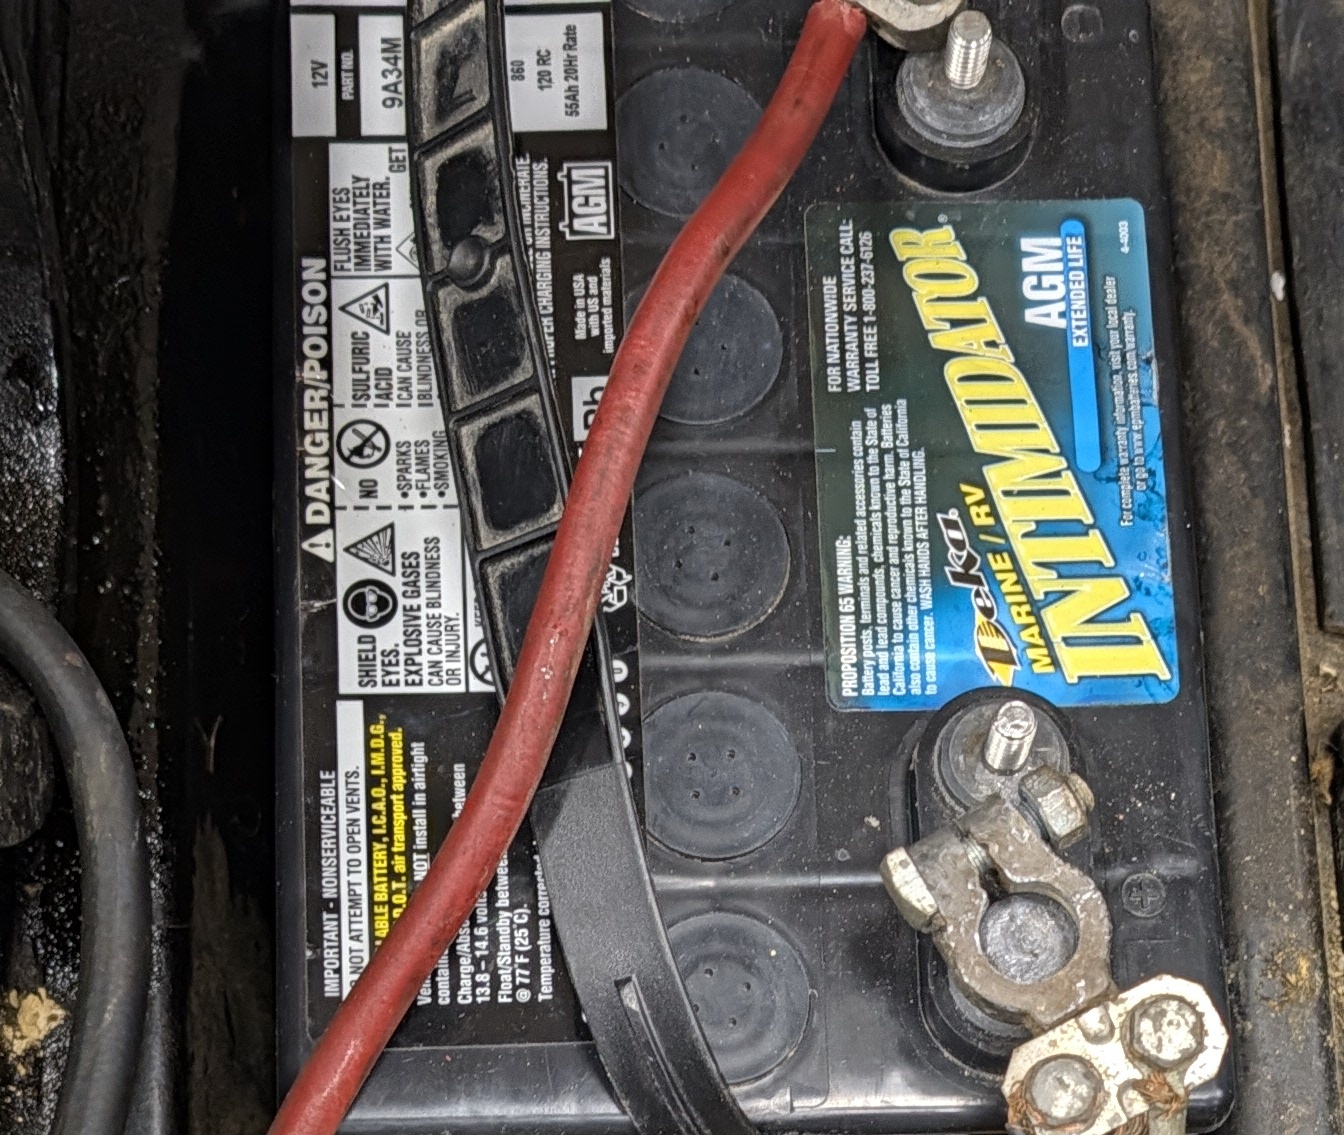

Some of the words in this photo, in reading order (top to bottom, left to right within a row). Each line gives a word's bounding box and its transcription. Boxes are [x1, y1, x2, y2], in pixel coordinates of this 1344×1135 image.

[564, 24, 578, 52] Rate
[311, 60, 328, 88] 12V
[341, 48, 354, 70] NO.
[381, 37, 404, 109] 9A34M
[510, 60, 525, 81] 860
[537, 48, 552, 67] RC
[564, 54, 579, 82] 20Hr
[342, 72, 354, 100] PART
[537, 70, 553, 91] 120
[564, 84, 580, 117] 55Ah
[389, 147, 406, 173] GET
[332, 188, 350, 224] EYES
[374, 176, 391, 230] WATER.
[532, 157, 551, 248] INSTRUCTIONS.
[572, 168, 608, 234] AGM
[352, 175, 372, 271] IMMEDIATELY
[839, 218, 854, 254] CALL:
[334, 228, 351, 272] FLUSH
[375, 235, 392, 271] WITH
[1066, 236, 1084, 267] LIFE
[536, 251, 553, 314] CHARGING
[572, 274, 585, 297] USA
[586, 276, 598, 296] and
[599, 257, 612, 304] materials
[841, 256, 858, 312] SERVICE
[858, 231, 877, 322] 1-800-237-6126
[1021, 236, 1067, 329] AGM
[1104, 276, 1118, 304] dealer
[574, 299, 586, 308] in
[587, 298, 598, 312] US
[822, 275, 841, 364] NATIONWIDE
[1068, 270, 1090, 347] EXTENDED
[1106, 306, 1120, 328] local
[574, 310, 586, 339] Made
[588, 314, 600, 337] with
[600, 306, 615, 354] imported
[862, 325, 878, 357] FREE
[1109, 330, 1124, 350] your
[351, 331, 371, 402] SULFURIC
[396, 331, 412, 372] CAUSE
[417, 330, 434, 401] BLINDNESS
[843, 316, 861, 392] WARRANTY
[1109, 350, 1123, 370] visit
[302, 258, 331, 524] DANGER/POISON
[374, 367, 394, 402] ACID
[396, 374, 412, 401] CAN
[826, 366, 842, 392] FOR
[864, 359, 880, 392] TOLL
[864, 407, 877, 418] of
[880, 403, 894, 448] Batteries
[894, 398, 910, 446] California
[849, 420, 863, 457] contain
[864, 420, 878, 446] State
[1115, 426, 1132, 466] warranty
[396, 440, 412, 490] SPARKS
[414, 440, 430, 490] FLAMES
[432, 430, 450, 490] SMOKING
[866, 448, 880, 464] the
[868, 465, 880, 476] to
[882, 450, 896, 480] harm.
[889, 225, 1171, 683] INTIMIDATOR
[896, 448, 910, 459] of
[1132, 456, 1146, 466] to
[359, 479, 378, 499] NO
[852, 458, 867, 518] accessories
[898, 460, 912, 486] State
[912, 447, 928, 504] HANDLING.
[1118, 467, 1135, 508] complete
[1135, 481, 1147, 490] or
[1136, 468, 1149, 480] go
[868, 477, 882, 510] known
[899, 488, 912, 505] the
[960, 482, 995, 526] RV
[884, 482, 900, 544] reproductive
[900, 506, 913, 518] to
[914, 506, 930, 540] AFTER
[1120, 510, 1134, 527] For
[854, 520, 868, 554] related
[869, 512, 884, 562] chemicals
[901, 519, 915, 552] known
[978, 532, 1005, 544] /
[424, 536, 441, 608] BLINDNESS
[835, 535, 853, 595] WARNING:
[856, 556, 870, 575] and
[886, 546, 900, 564] and
[916, 541, 931, 576] HANDS
[401, 551, 420, 598] GASES
[890, 566, 902, 599] cancer
[902, 553, 918, 603] chemicals
[838, 596, 854, 612] 65
[857, 576, 871, 624] terminals
[873, 564, 888, 624] compounds,
[918, 578, 932, 610] WASH
[937, 511, 1018, 680] Deka
[890, 601, 904, 630] cause
[904, 605, 919, 631] other
[989, 552, 1056, 673] MARINE
[403, 604, 423, 687] EXPLOSIVE
[426, 612, 442, 655] CAUSE
[444, 612, 460, 663] INJURY.
[874, 626, 888, 648] lead
[892, 632, 904, 643] to
[921, 611, 936, 650] cancer.
[358, 636, 378, 688] SHIELD
[382, 644, 400, 687] EYES.
[839, 615, 858, 696] PROPOSITION
[876, 652, 889, 670] and
[906, 632, 920, 672] contain
[922, 652, 936, 682] cause
[427, 660, 444, 686] CAN
[446, 668, 462, 686] OR
[861, 660, 876, 696] Battery
[877, 672, 890, 696] lead
[892, 646, 906, 695] California
[908, 672, 922, 695] also
[924, 684, 937, 695] to
[370, 714, 388, 775] I.M.D.G.,
[388, 727, 406, 792] approved.
[410, 742, 428, 790] airtight
[344, 765, 360, 814] VENTS.
[412, 793, 426, 806] in
[320, 770, 338, 898] NONSERVICEABLE
[345, 817, 361, 855] OPEN
[390, 794, 407, 852] transport
[412, 810, 426, 849] install
[346, 860, 362, 876] TO
[372, 836, 389, 901] BATTERY,
[391, 856, 406, 874] air
[413, 853, 430, 880] NOT
[347, 880, 363, 943] ATTEMPT
[323, 912, 340, 997] IMPORTANT
[474, 926, 489, 958] 14.6
[495, 911, 513, 1003] Float/Standby
[348, 946, 364, 974] NOT
[536, 919, 554, 1002] Temperature
[476, 972, 490, 1003] 13.8
[516, 988, 532, 1002] @
